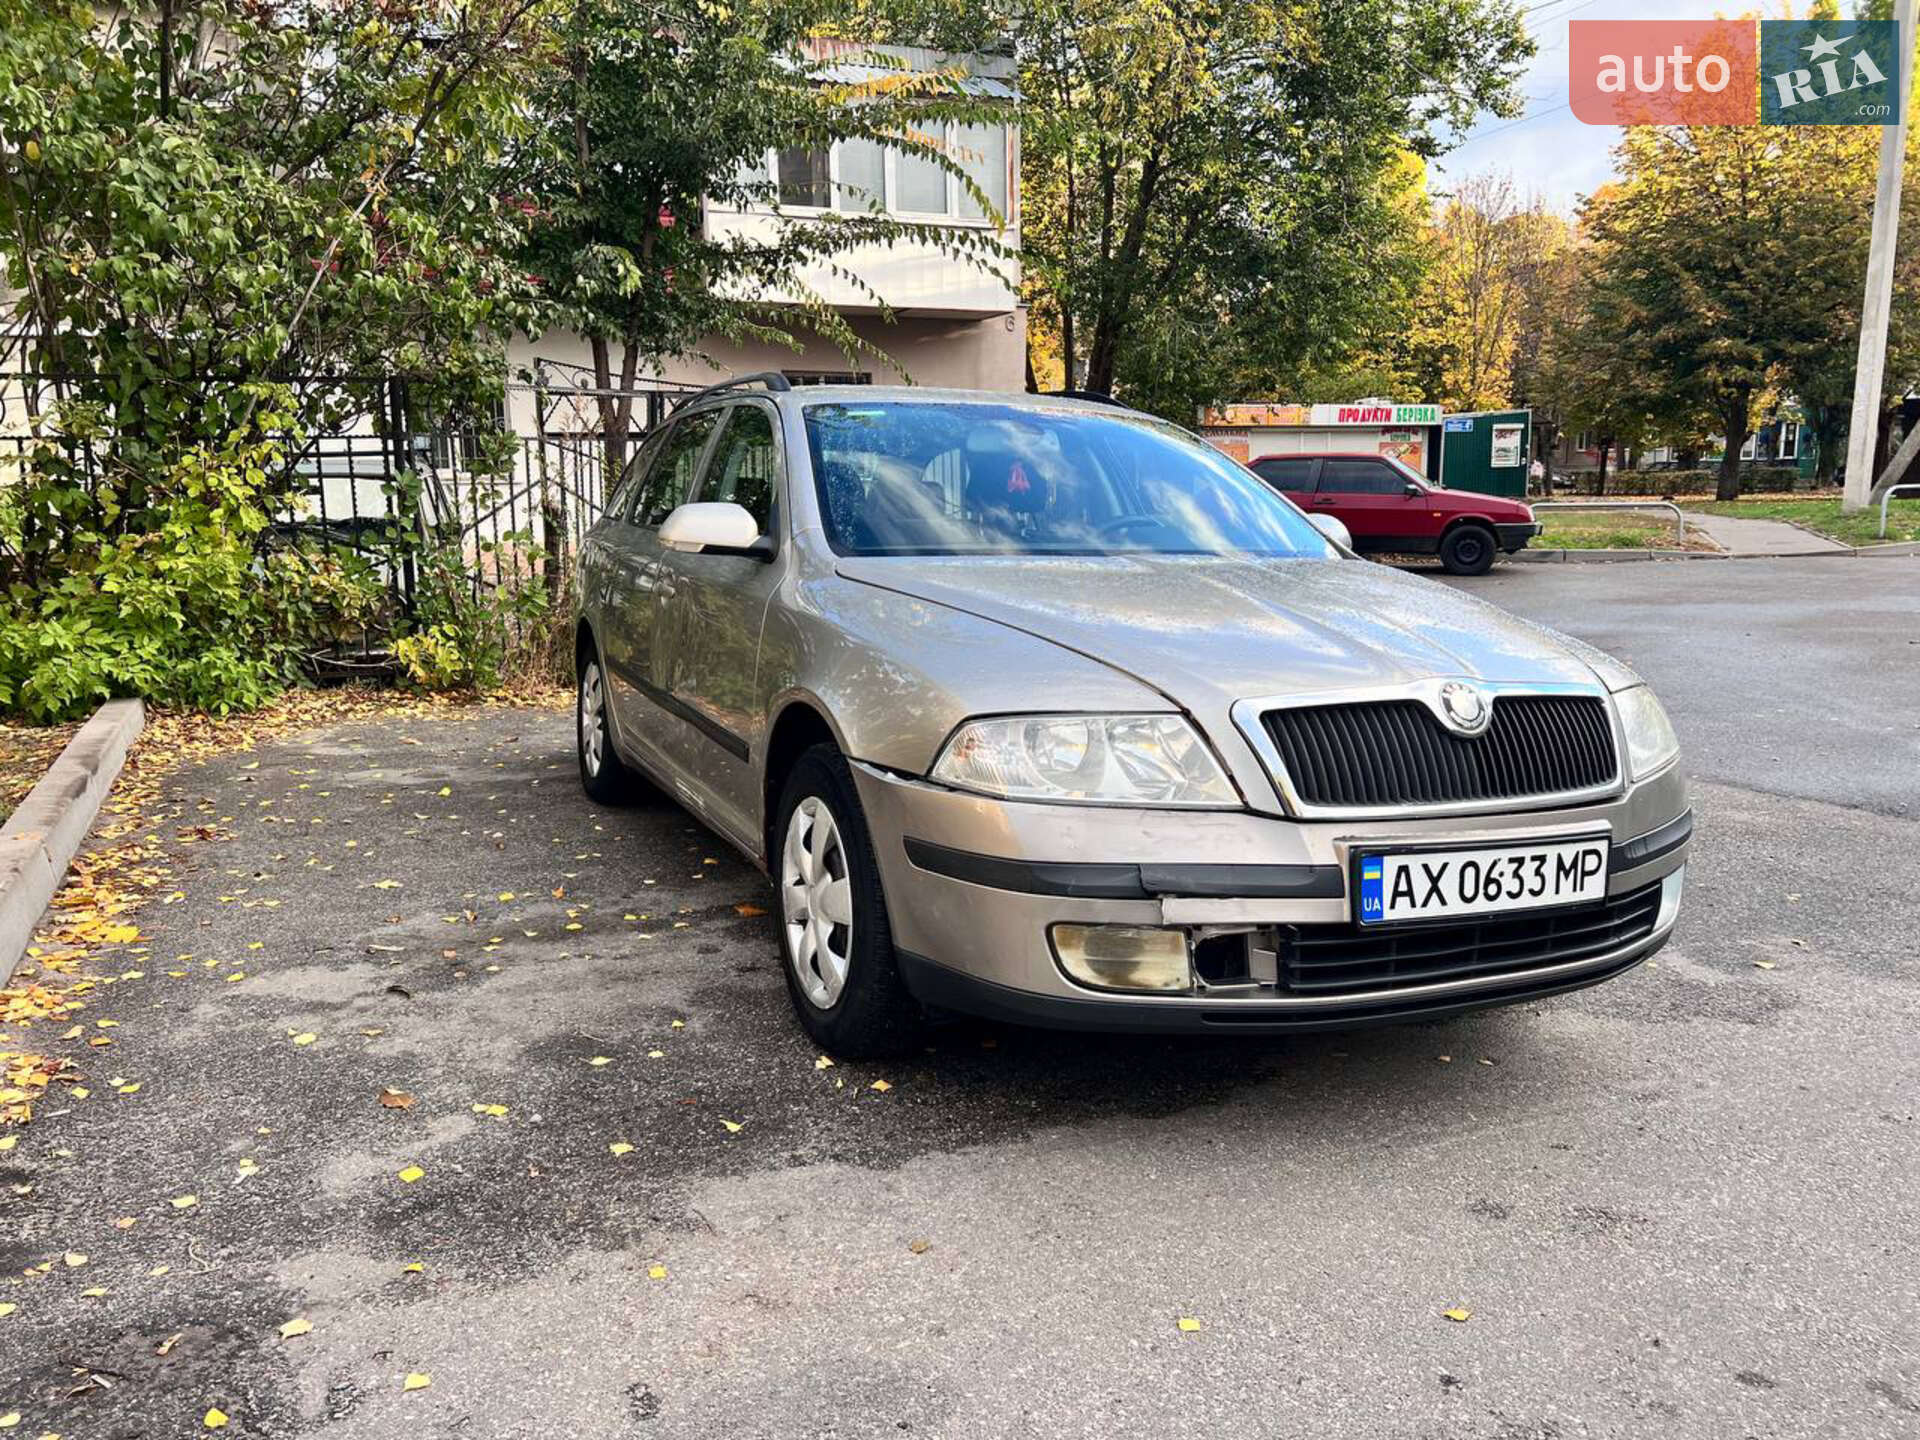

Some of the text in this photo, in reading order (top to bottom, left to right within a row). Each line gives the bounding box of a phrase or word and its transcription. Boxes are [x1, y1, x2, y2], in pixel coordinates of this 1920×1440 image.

[1338, 407, 1436, 423] ПРОДУКТИ БЕРІЗКА
[1363, 848, 1603, 913] UA AX 0633 MP
